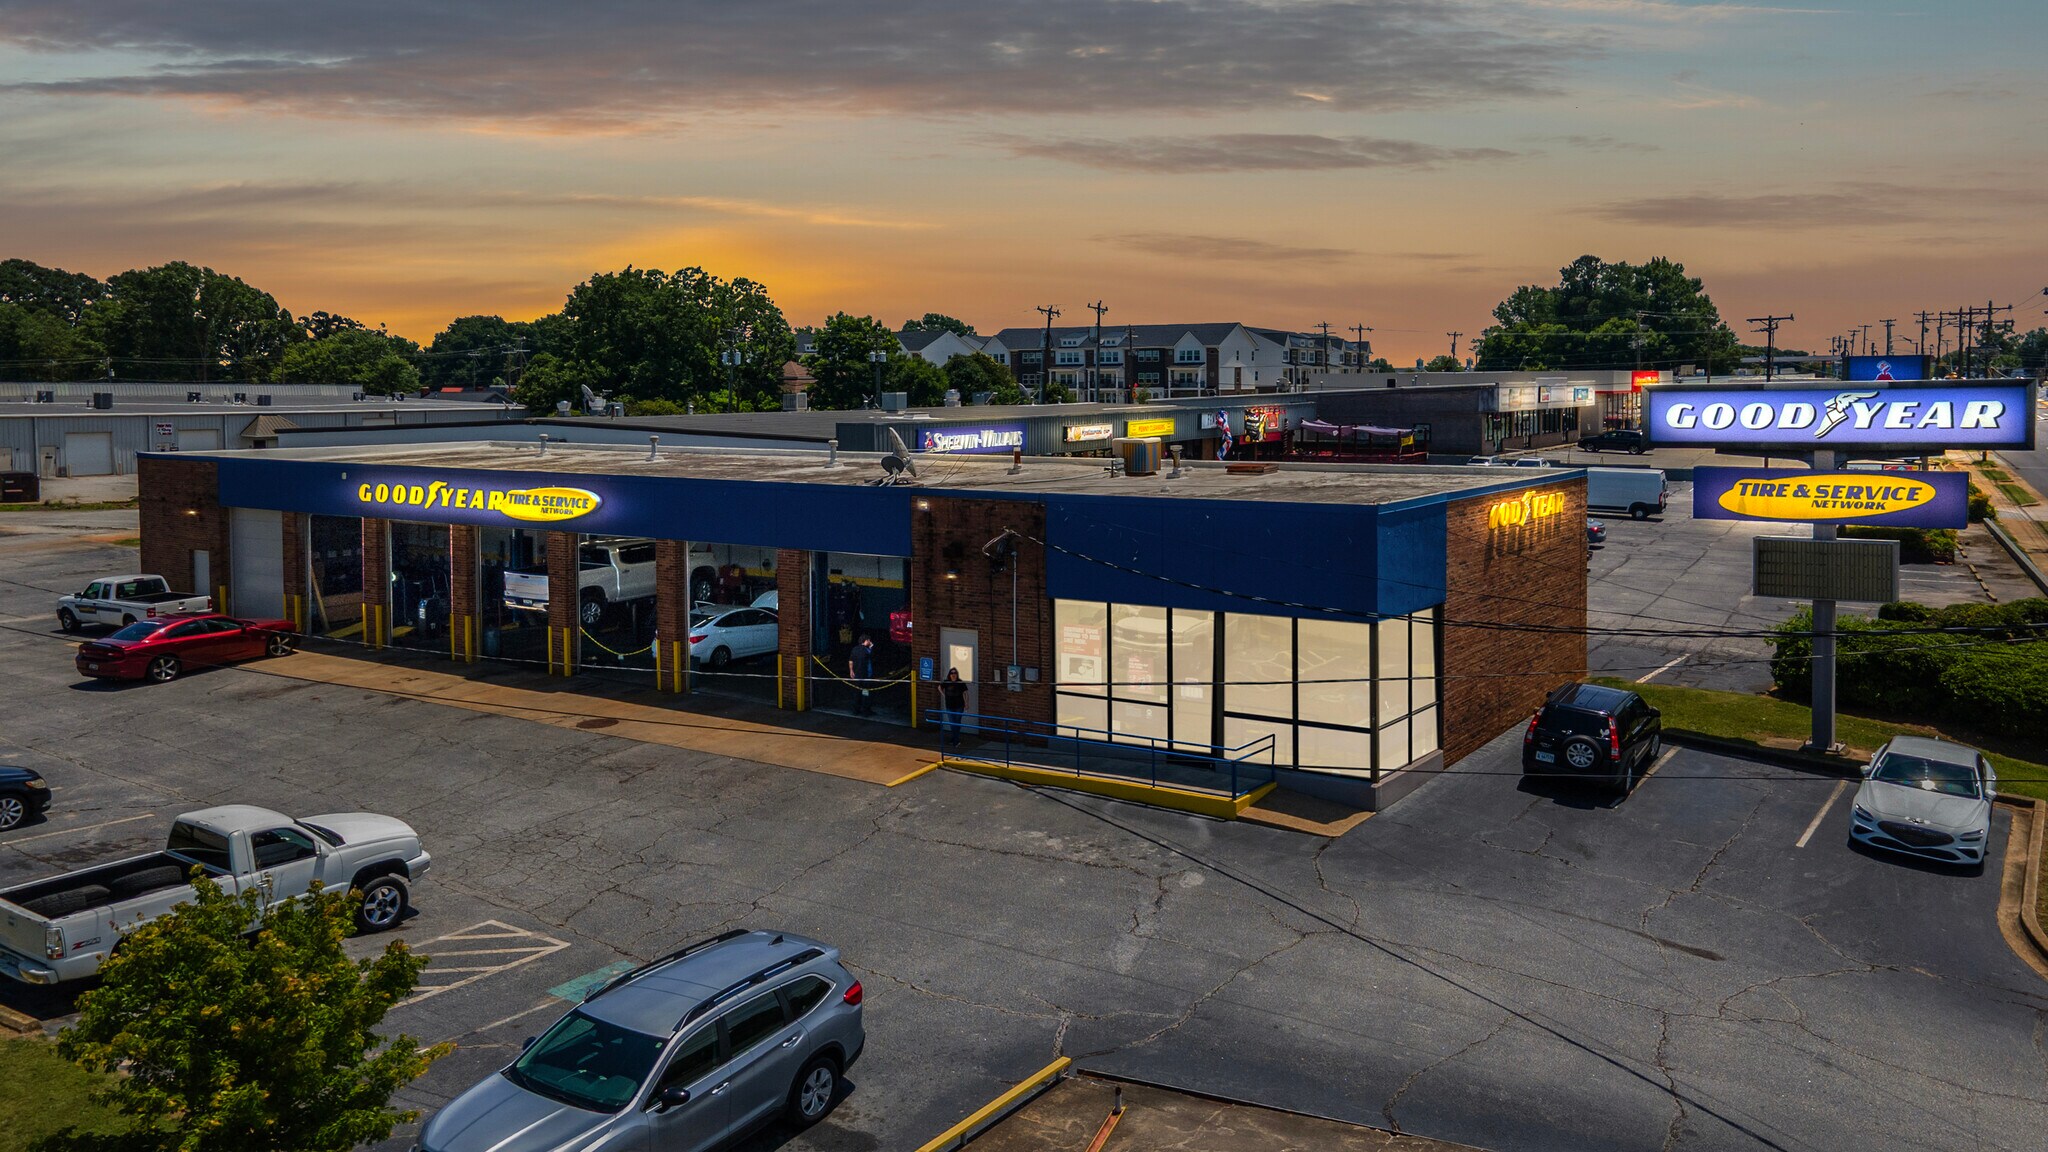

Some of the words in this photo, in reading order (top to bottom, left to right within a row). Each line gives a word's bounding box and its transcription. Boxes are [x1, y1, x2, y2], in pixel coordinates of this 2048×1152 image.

[1738, 483, 1787, 498] TIRE
[1792, 484, 1811, 498] &
[1814, 485, 1921, 501] SERVICE
[508, 494, 532, 505] TIRE
[541, 496, 589, 509] SERVICE
[1811, 500, 1887, 510] NETWORK
[540, 507, 574, 515] NETWORK
